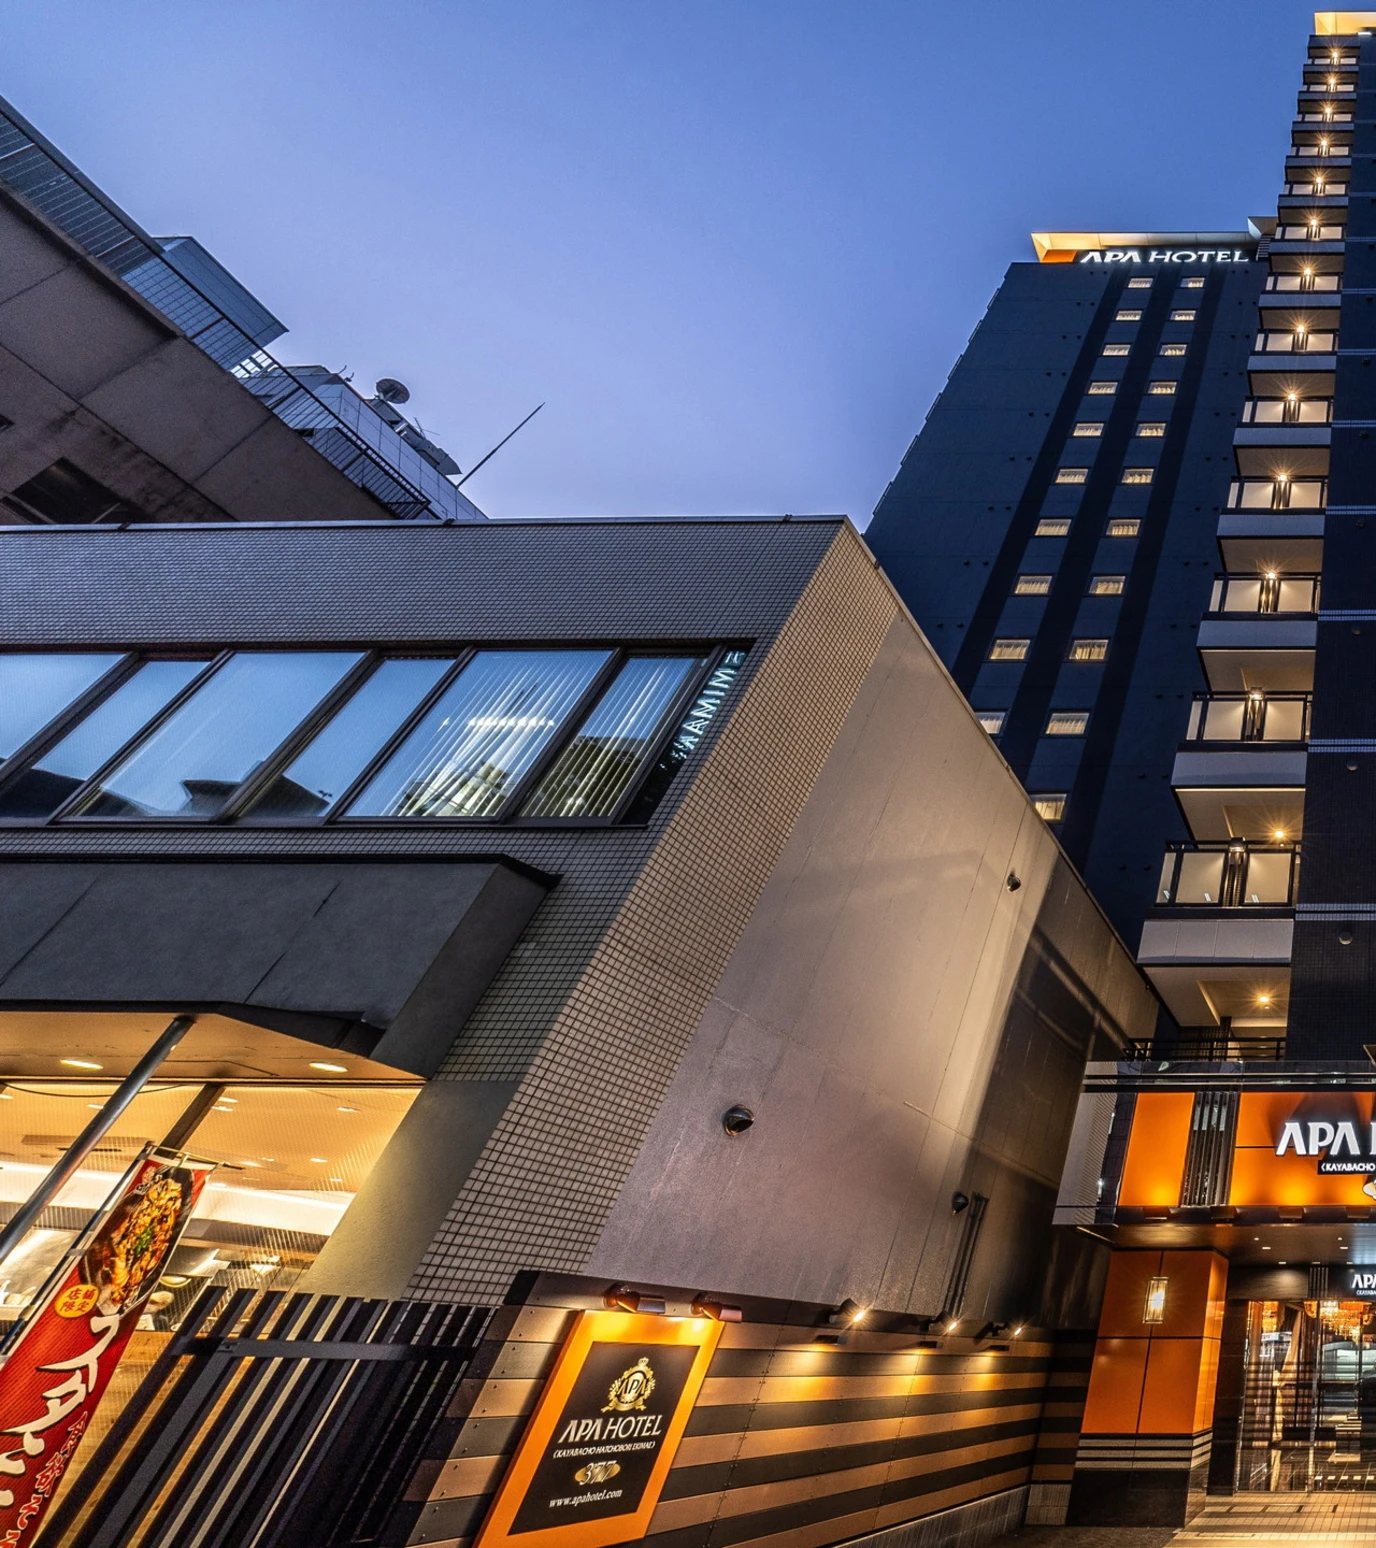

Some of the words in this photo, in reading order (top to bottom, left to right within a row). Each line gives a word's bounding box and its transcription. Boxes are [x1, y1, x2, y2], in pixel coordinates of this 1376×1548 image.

[1080, 250, 1142, 263] APA
[1148, 250, 1249, 263] HOTEL
[1275, 1121, 1361, 1157] APA
[558, 1417, 602, 1443] APA
[602, 1414, 663, 1441] HOTEL
[549, 1489, 623, 1508] www.apahotel.com
